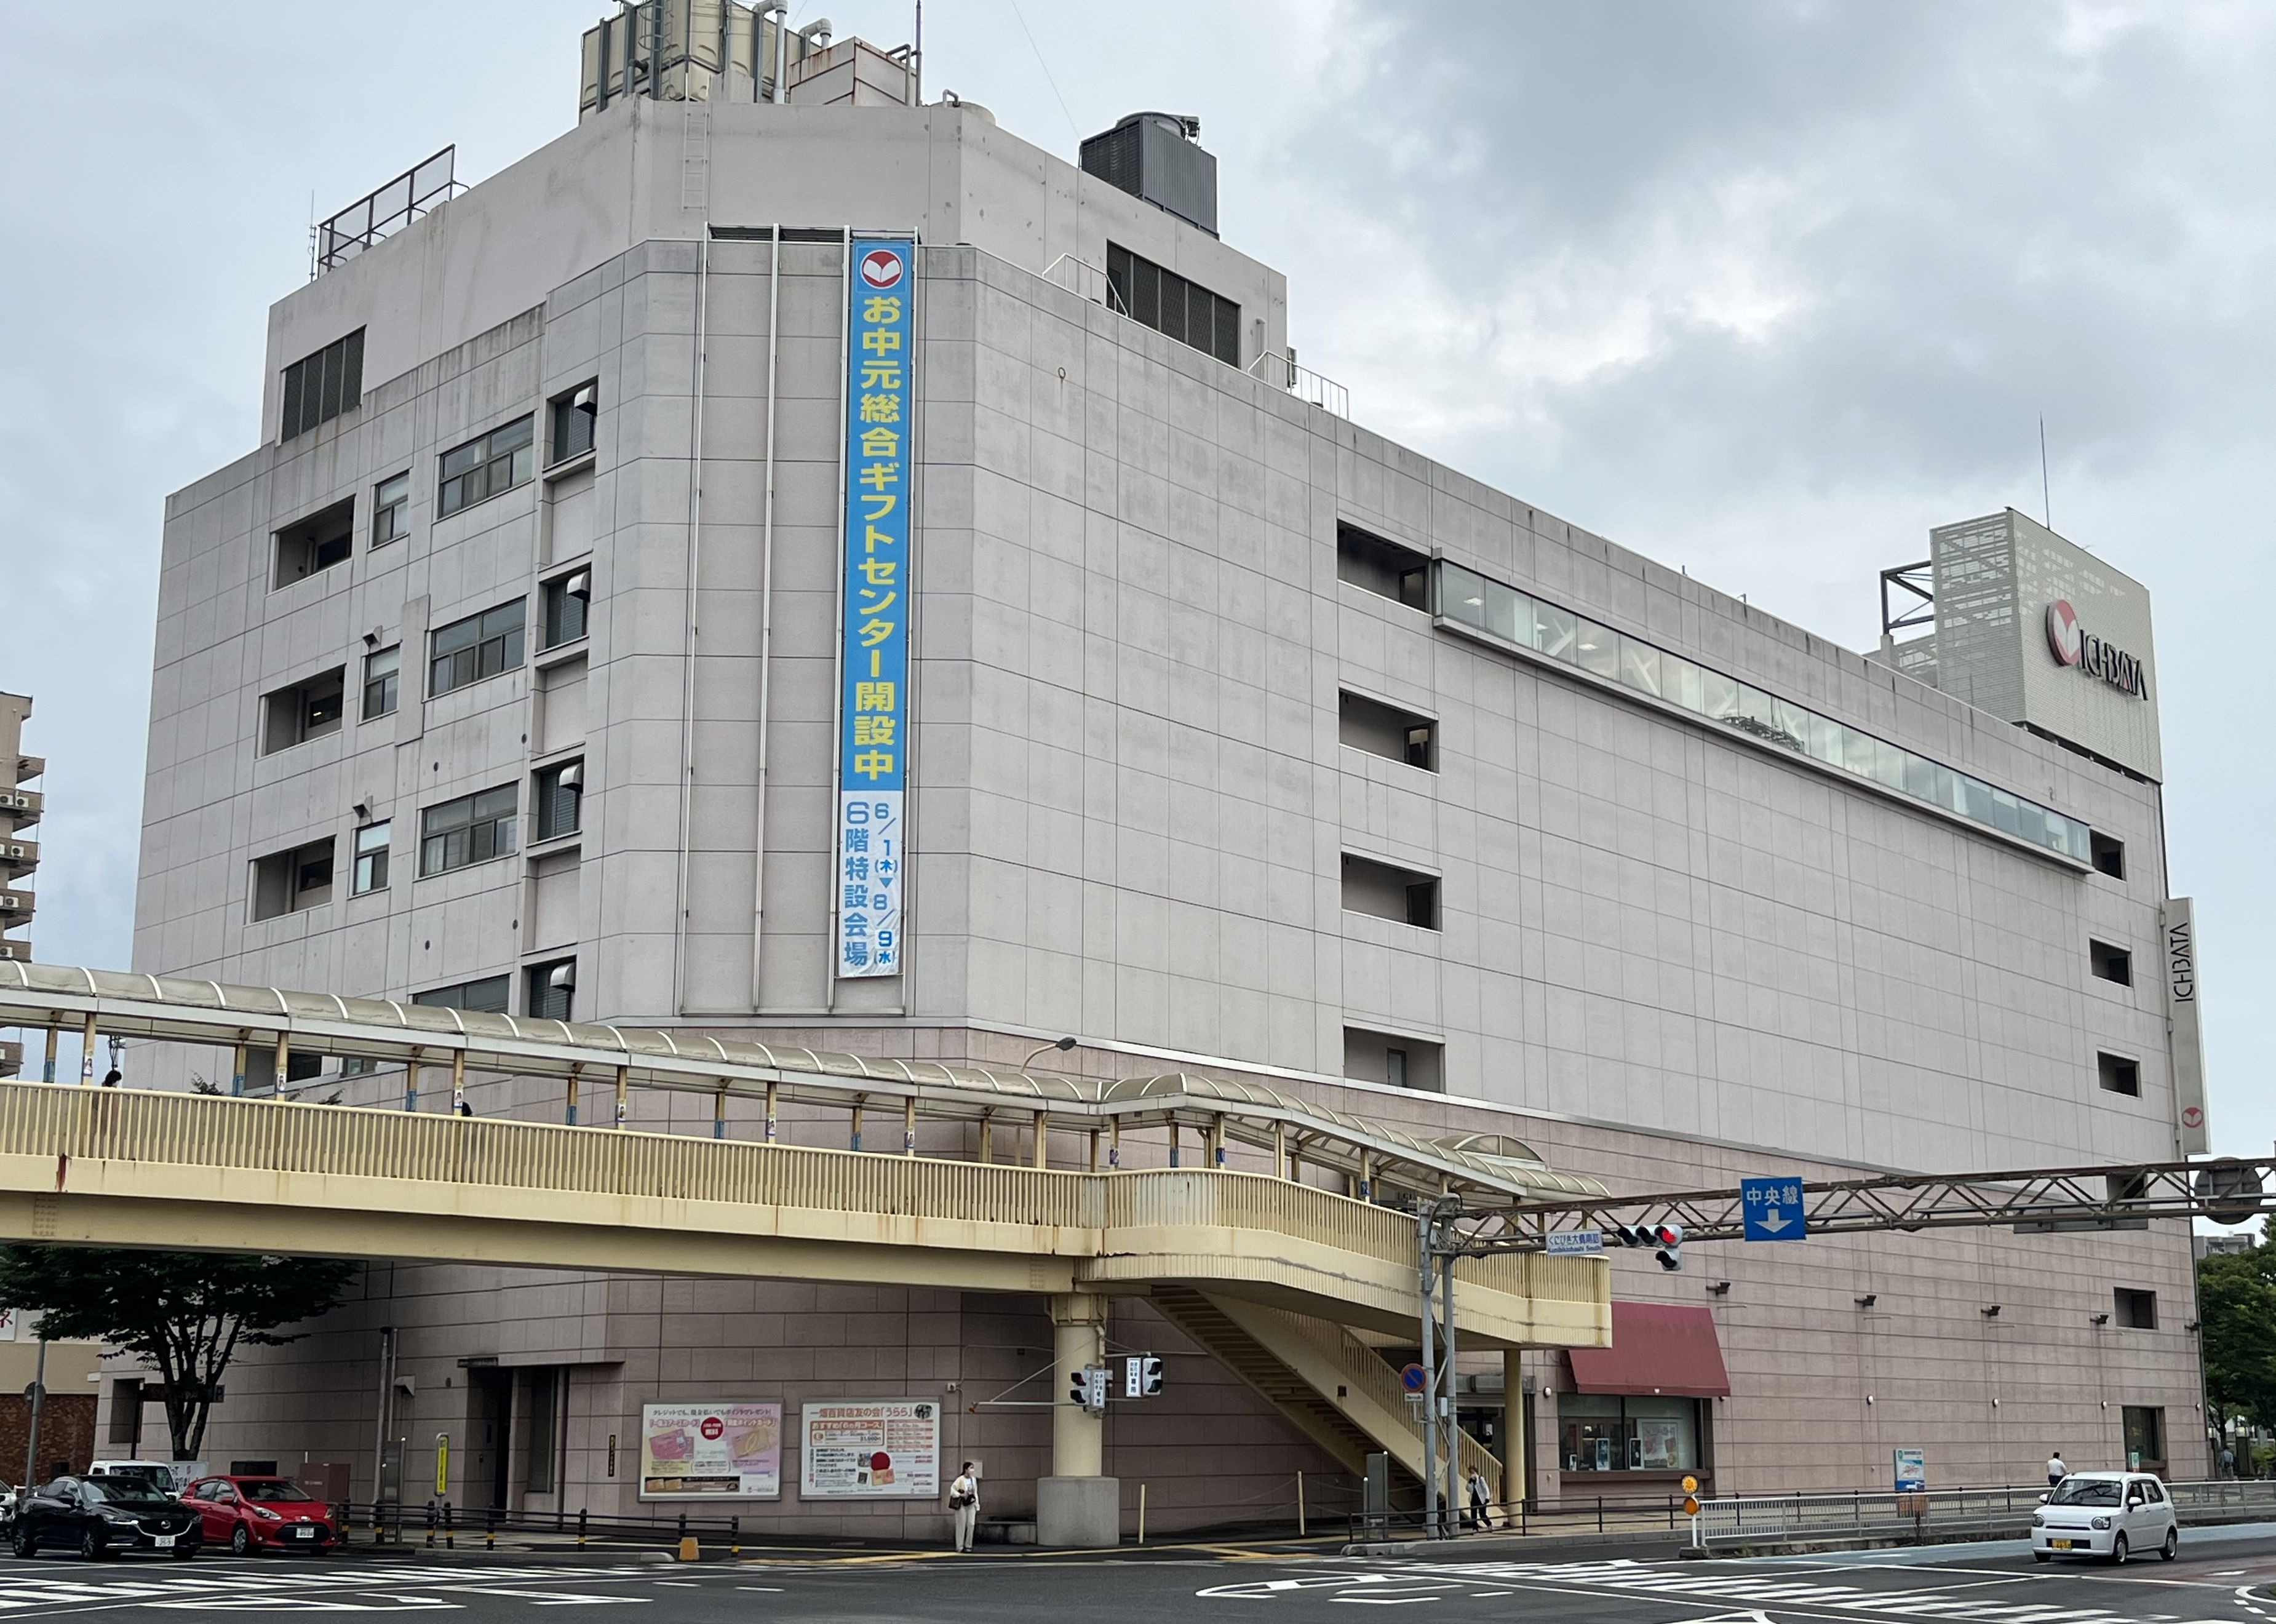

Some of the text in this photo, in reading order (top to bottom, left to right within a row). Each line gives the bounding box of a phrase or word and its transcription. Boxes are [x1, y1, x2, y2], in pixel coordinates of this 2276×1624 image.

[854, 296, 901, 781] お中元総合ギフトセンター開設中
[844, 801, 870, 966] 6階特設会場
[1746, 1185, 1799, 1206] 中央線
